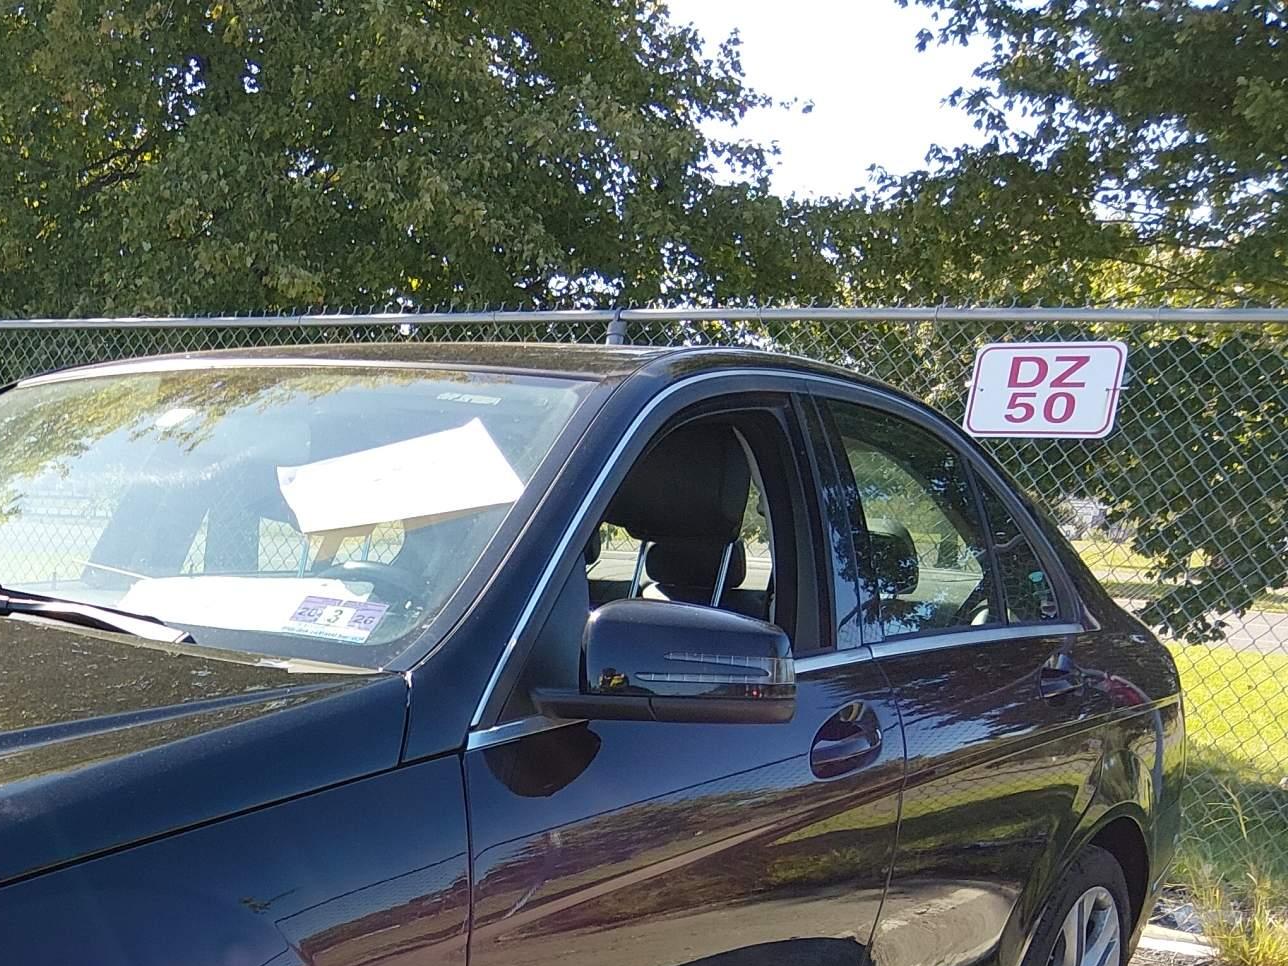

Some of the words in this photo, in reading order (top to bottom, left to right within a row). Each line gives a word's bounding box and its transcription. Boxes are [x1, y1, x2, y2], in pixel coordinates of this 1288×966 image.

[1007, 355, 1091, 388] DZ
[1004, 391, 1076, 424] 50
[326, 609, 343, 624] 3
